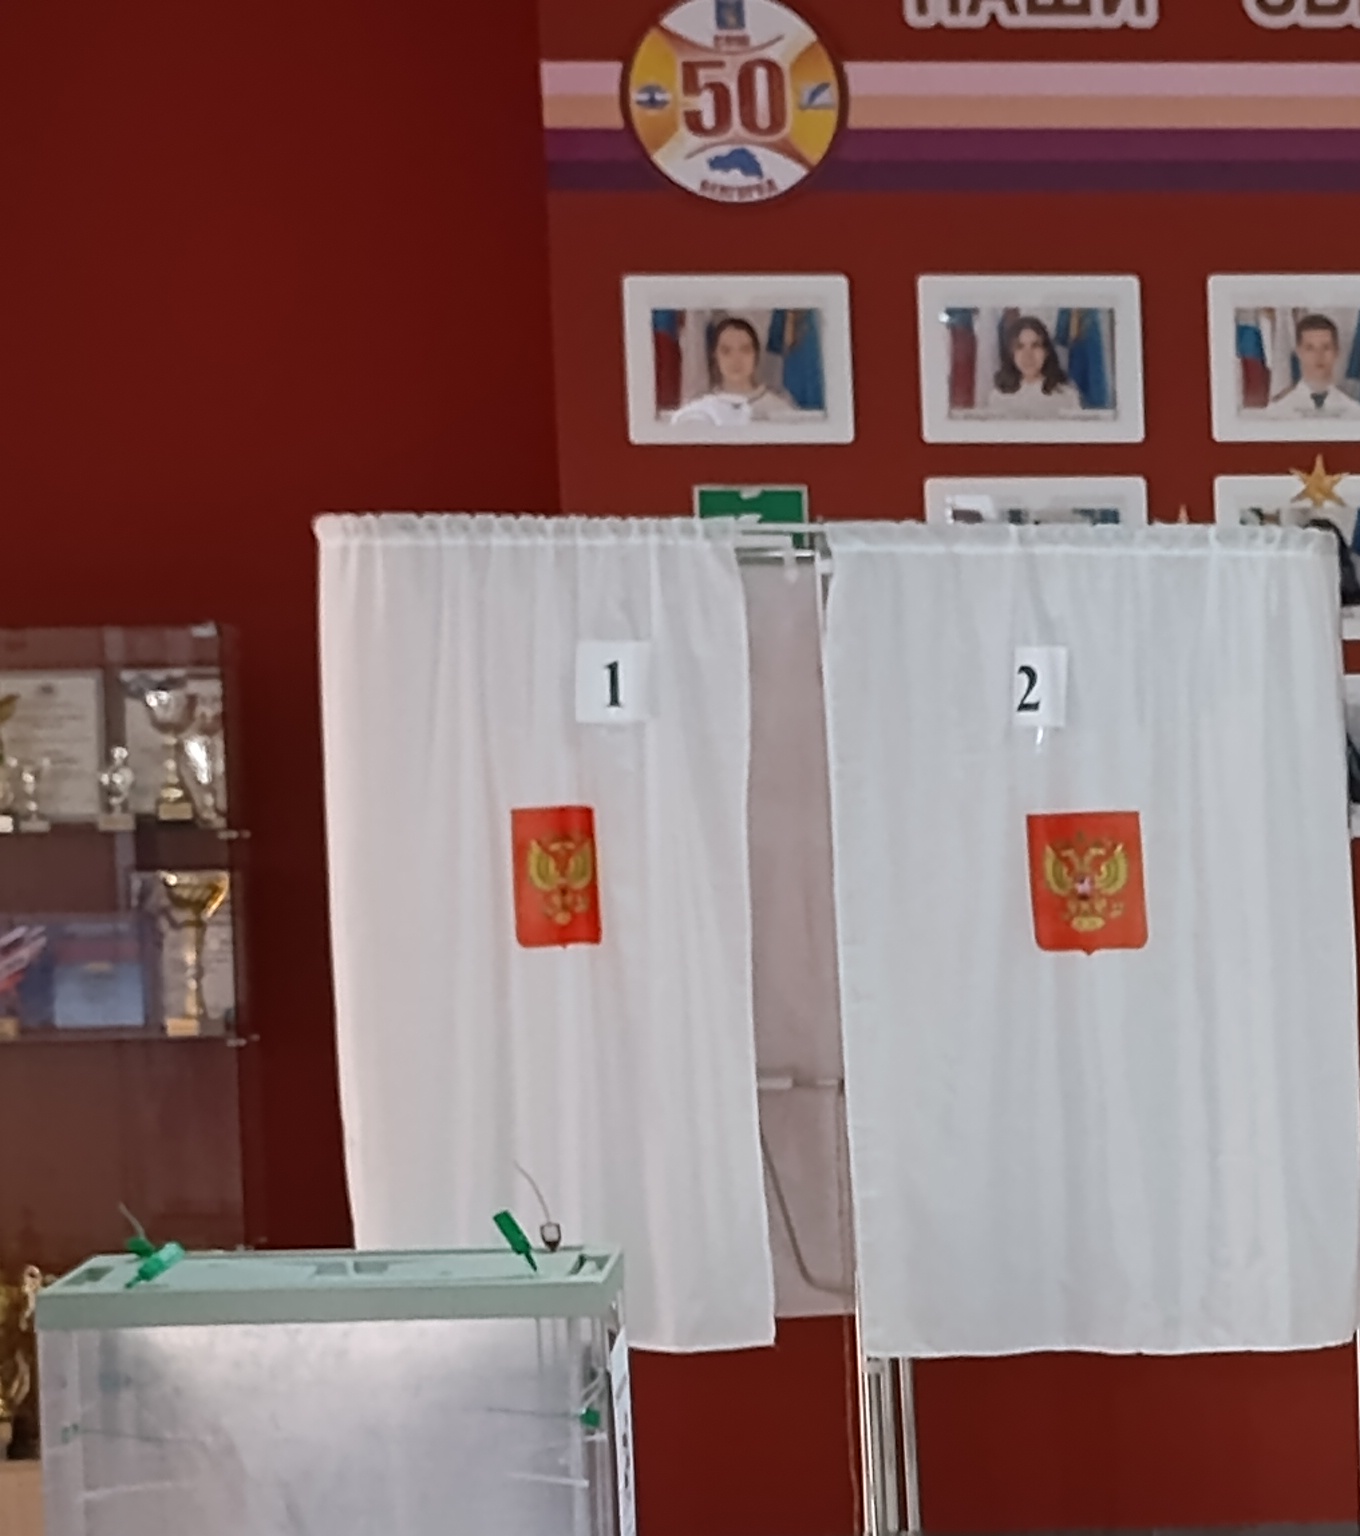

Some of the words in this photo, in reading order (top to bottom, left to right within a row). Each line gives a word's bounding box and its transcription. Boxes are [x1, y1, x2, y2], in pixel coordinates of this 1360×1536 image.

[682, 58, 787, 138] 50
[603, 660, 624, 709] 1
[1017, 665, 1041, 713] 2
